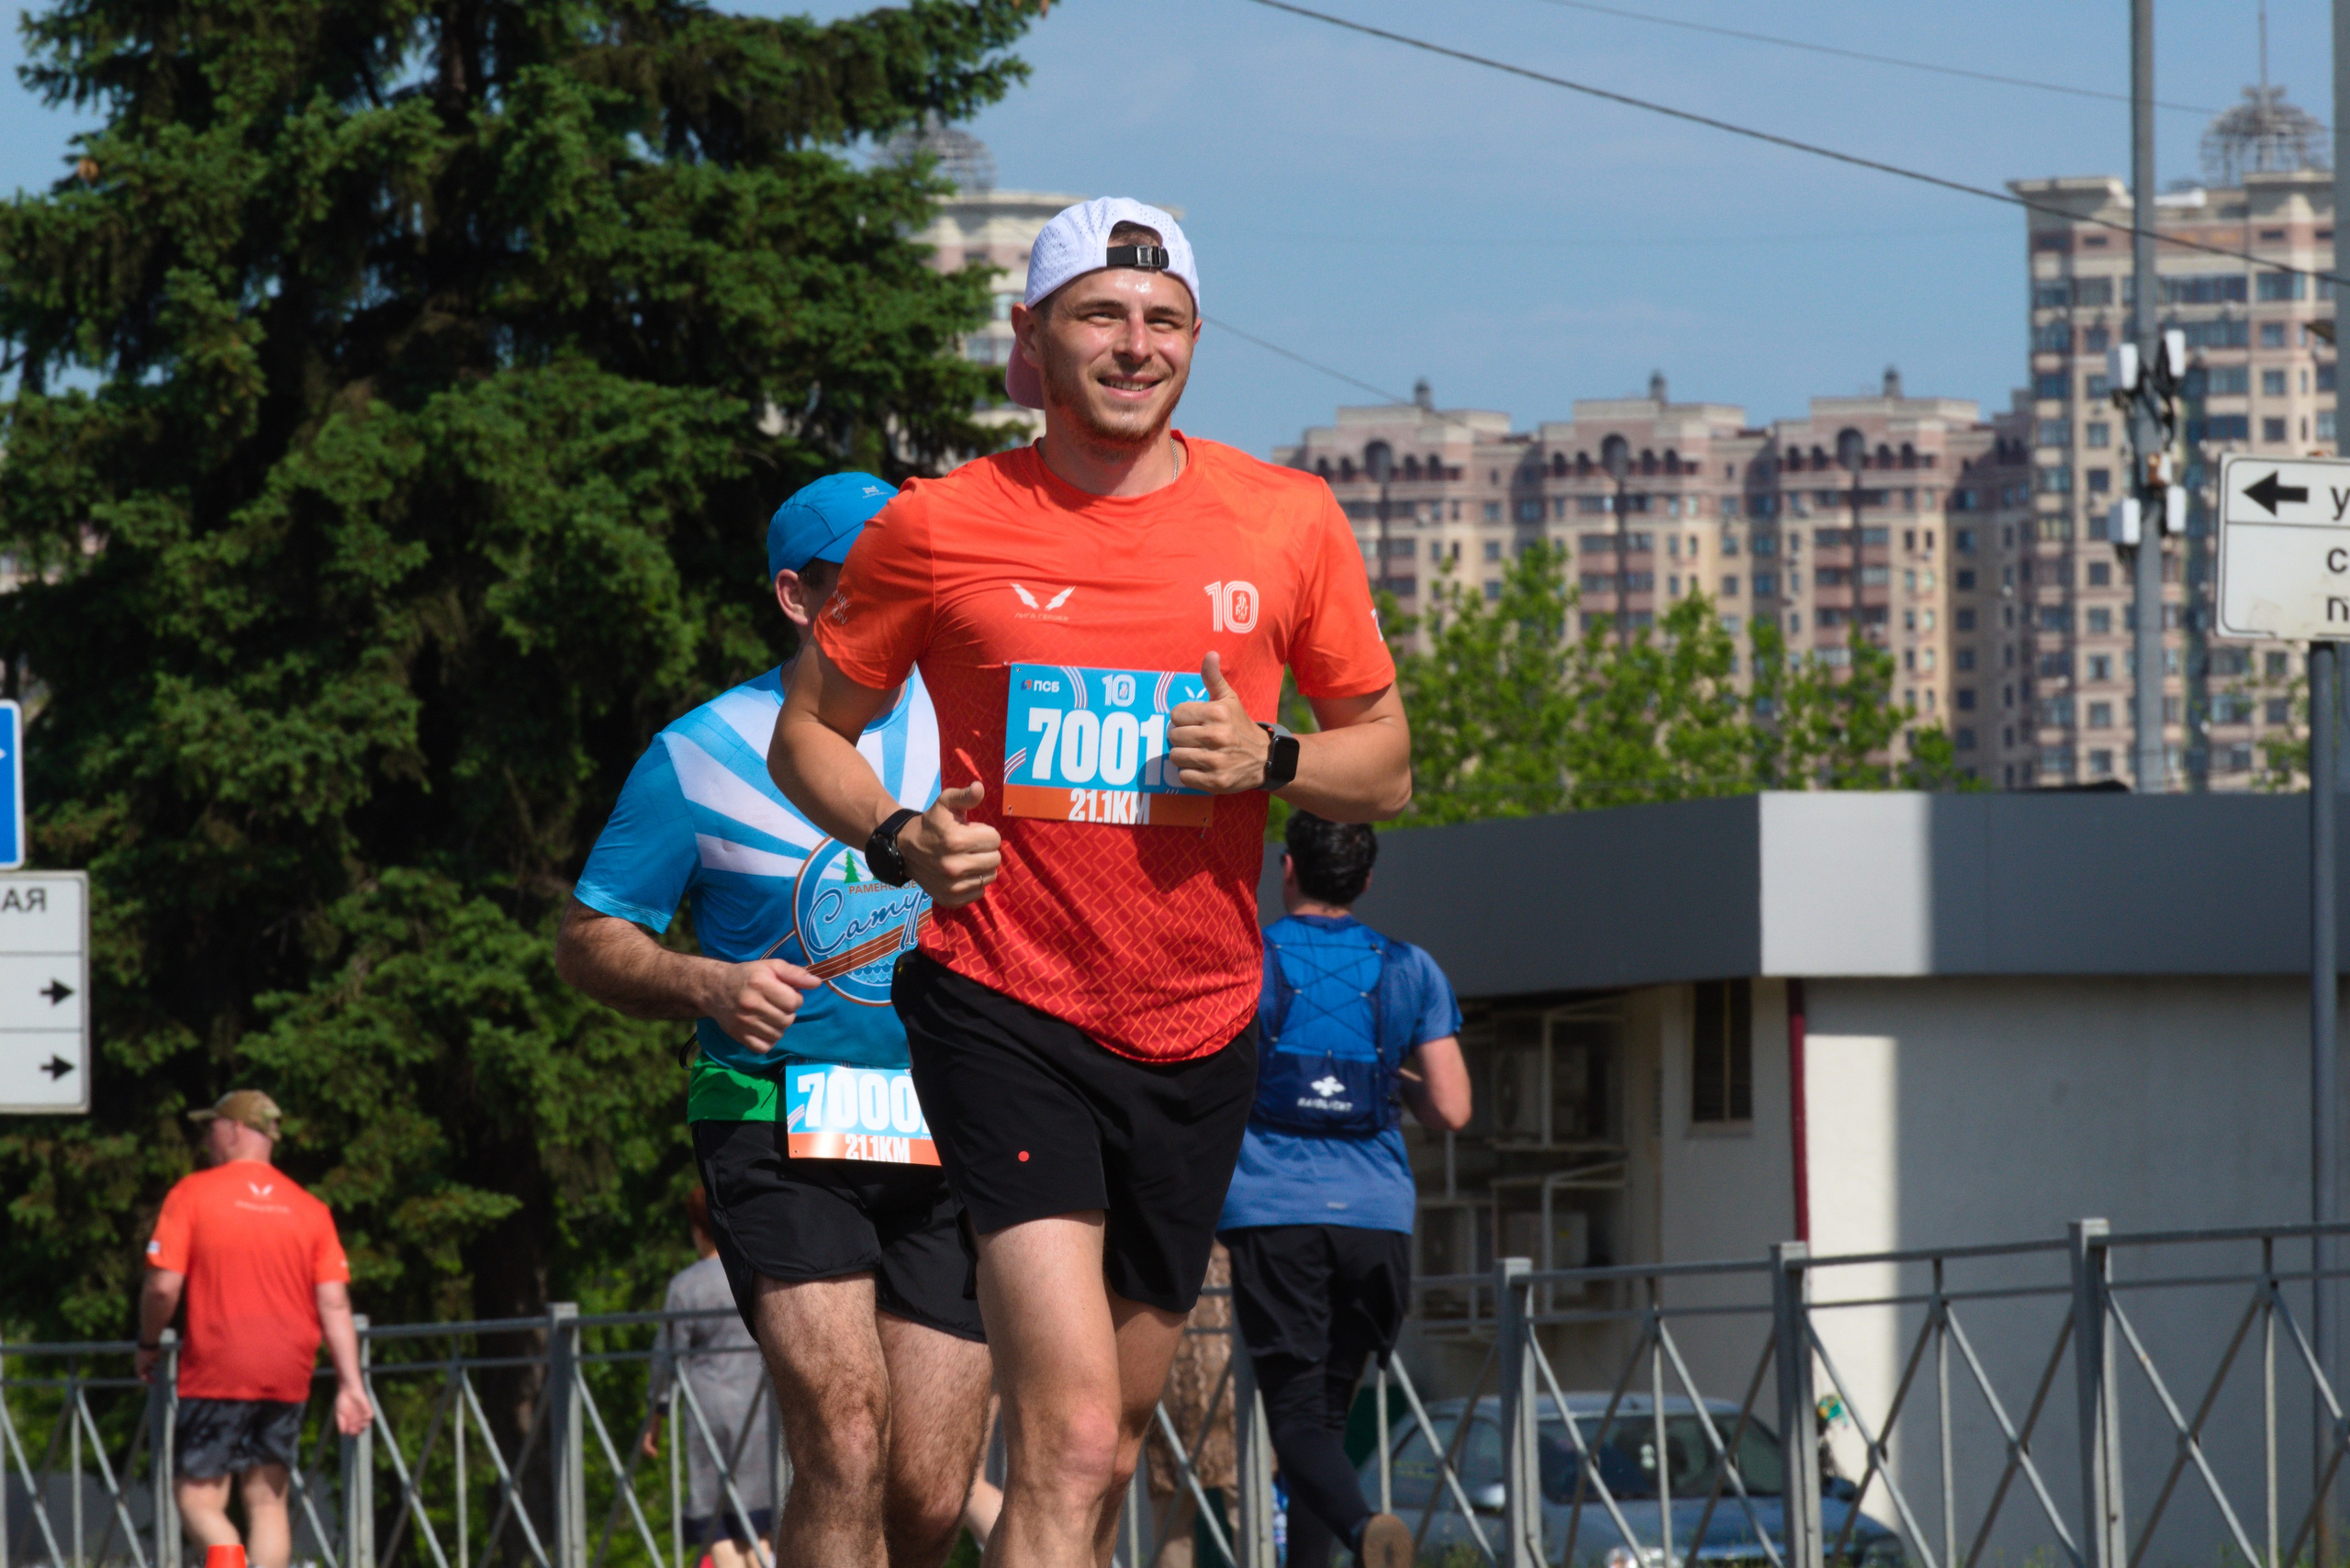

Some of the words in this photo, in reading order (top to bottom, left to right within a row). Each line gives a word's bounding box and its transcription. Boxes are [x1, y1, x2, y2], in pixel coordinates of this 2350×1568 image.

[1204, 580, 1259, 633] 10
[1034, 679, 1060, 693] ПСБ
[1102, 674, 1136, 707] 10
[849, 879, 917, 895] РАМЕНСОЕ
[798, 1071, 930, 1134] 7000
